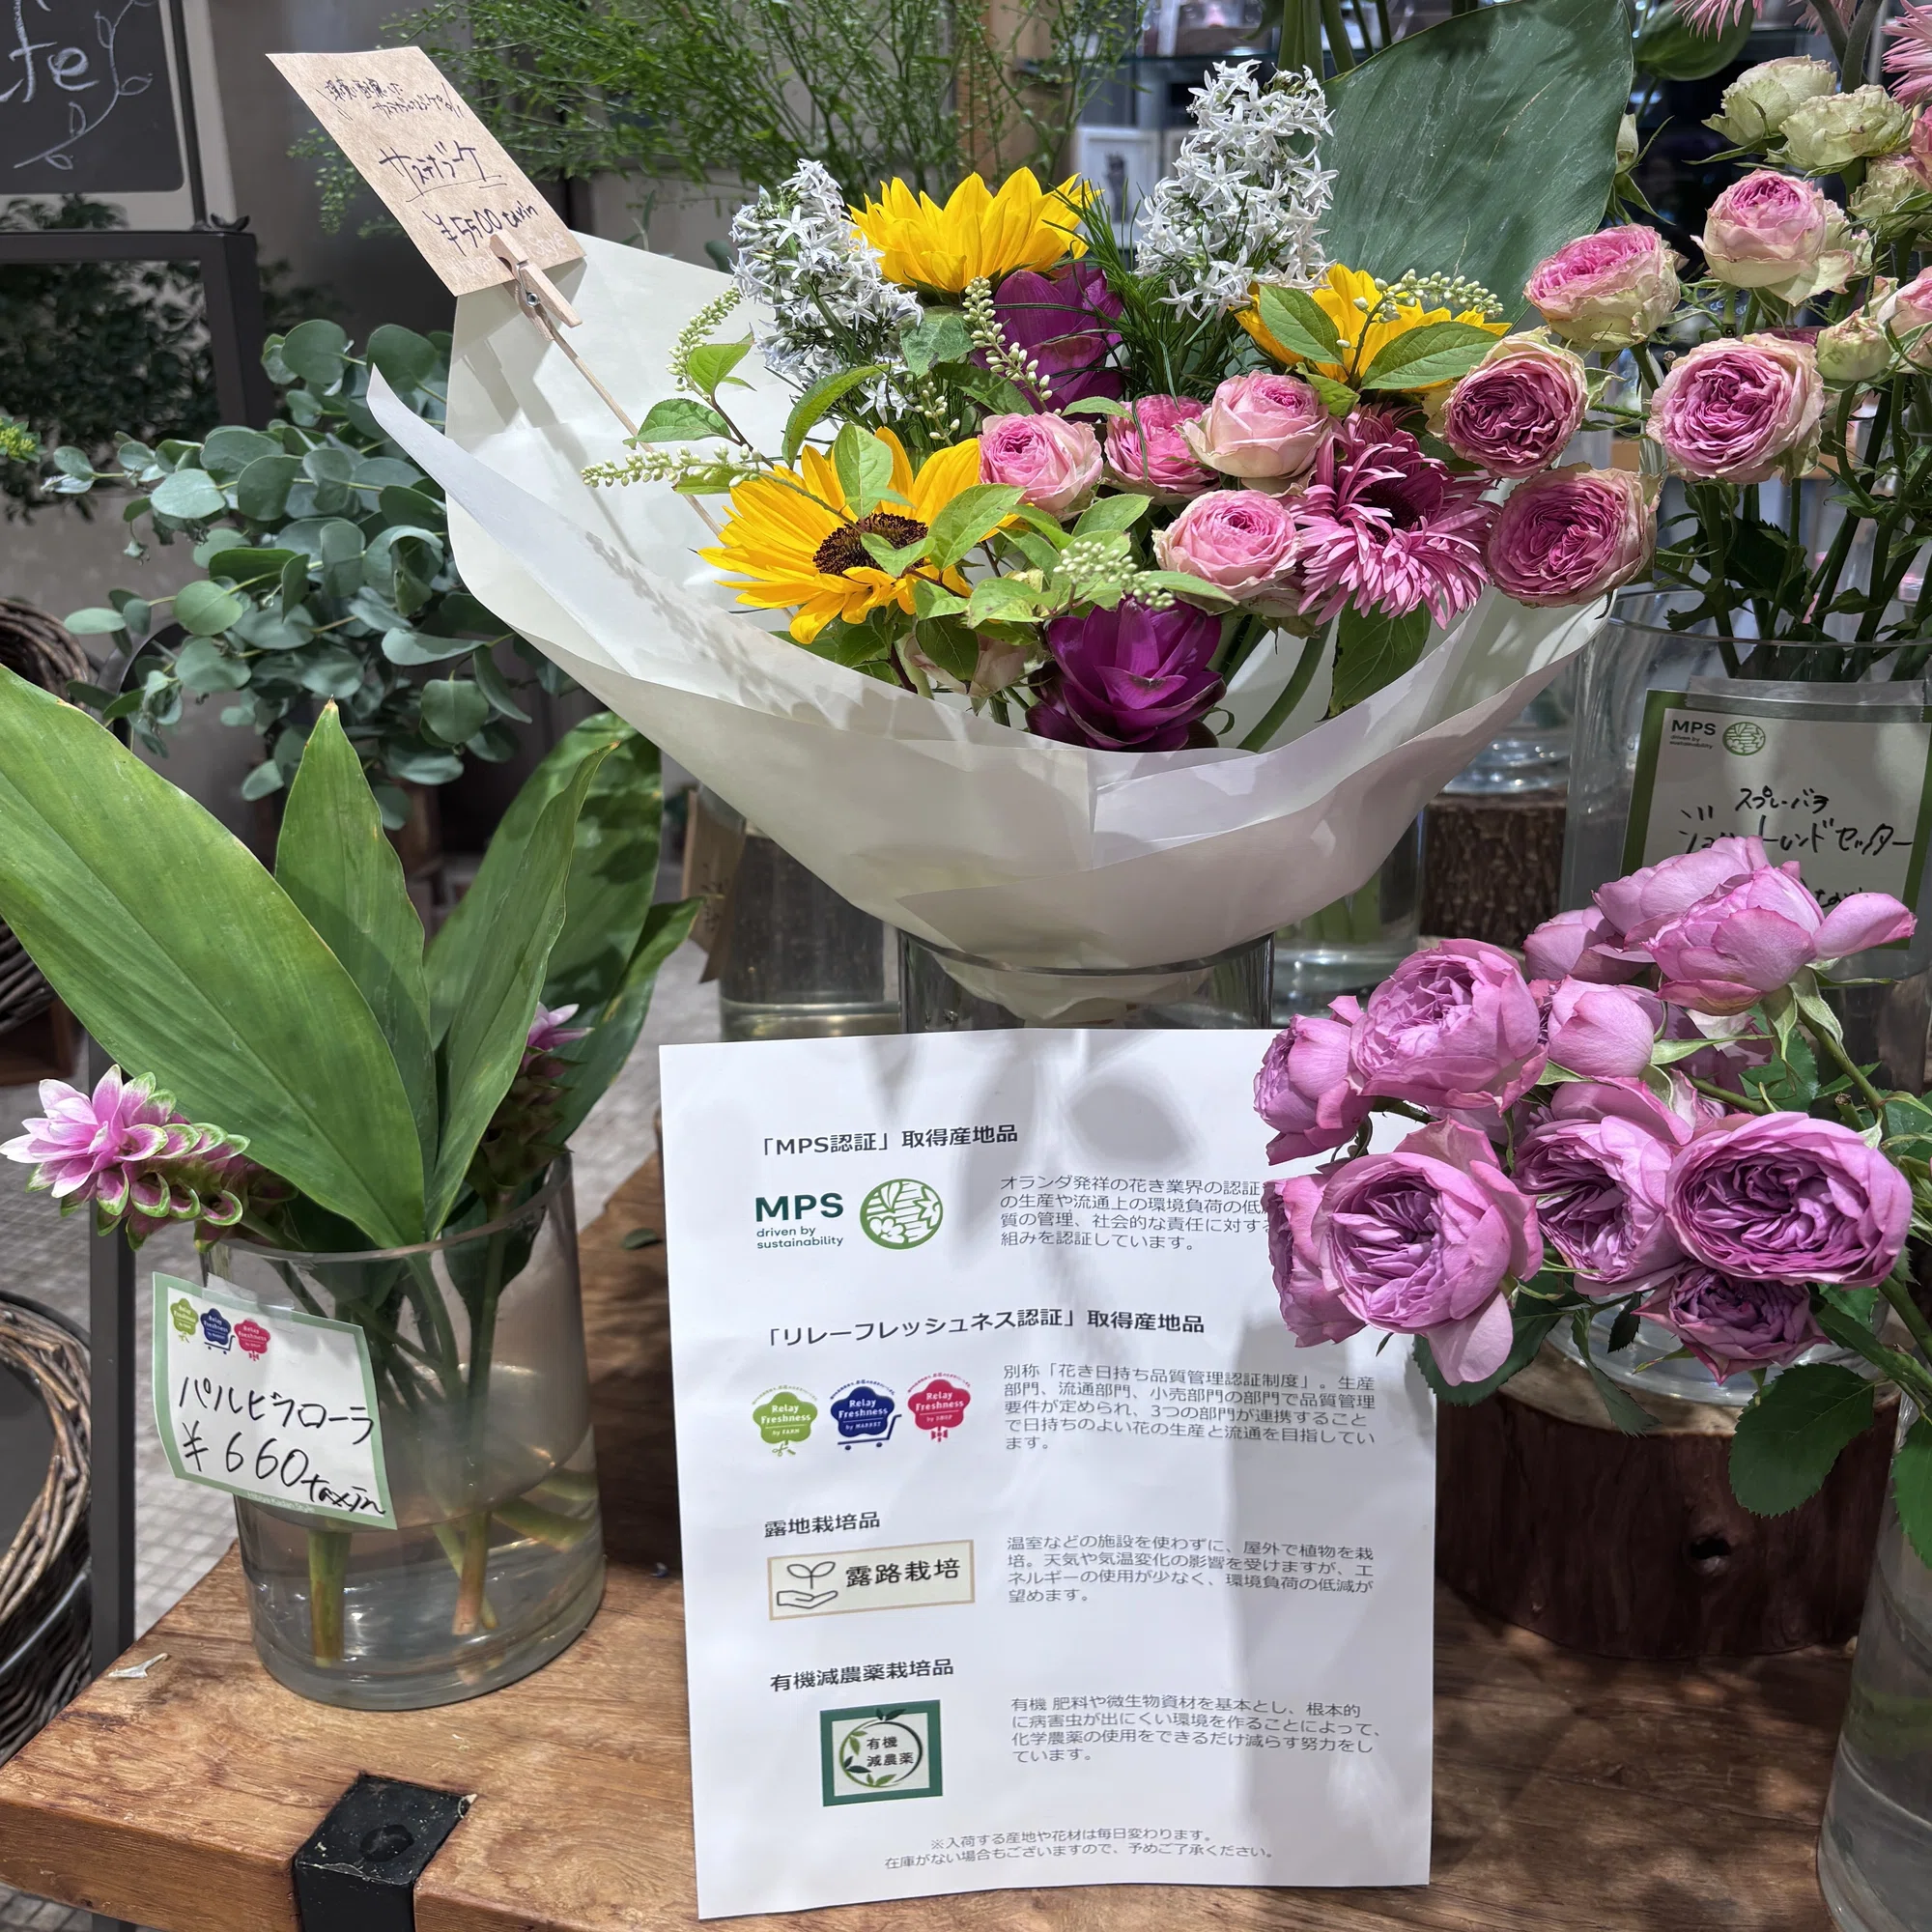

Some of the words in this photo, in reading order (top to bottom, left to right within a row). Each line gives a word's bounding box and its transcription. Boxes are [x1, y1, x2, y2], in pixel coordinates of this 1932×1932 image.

[0, 0, 99, 102] fe
[1671, 720, 1717, 736] MPS
[1669, 741, 1714, 750] sustainability
[1735, 785, 1830, 813] スプレーバラ
[755, 1192, 844, 1222] MPS
[1000, 1193, 1266, 1214] の生産や流通上の環境負荷の低
[756, 1225, 797, 1237] driven
[800, 1225, 816, 1237] by
[756, 1235, 844, 1249] sustainability
[1000, 1229, 1194, 1251] 組みを認証しています。
[849, 1398, 877, 1408] Relay
[926, 1391, 953, 1401] Relay
[771, 1404, 800, 1414] Relay
[838, 1407, 889, 1419] Freshness
[915, 1400, 965, 1412] Freshness
[760, 1413, 811, 1425] Freshness
[1005, 1435, 1050, 1451] ます。
[764, 1510, 880, 1538] 露地栽培品
[845, 1557, 961, 1588] 露路栽培
[1008, 1587, 1090, 1604] 望めます。
[769, 1658, 954, 1692] 有機減農薬栽培品
[866, 1736, 898, 1750] 有機
[866, 1751, 915, 1768] 減農薬
[1011, 1747, 1093, 1764] ています。
